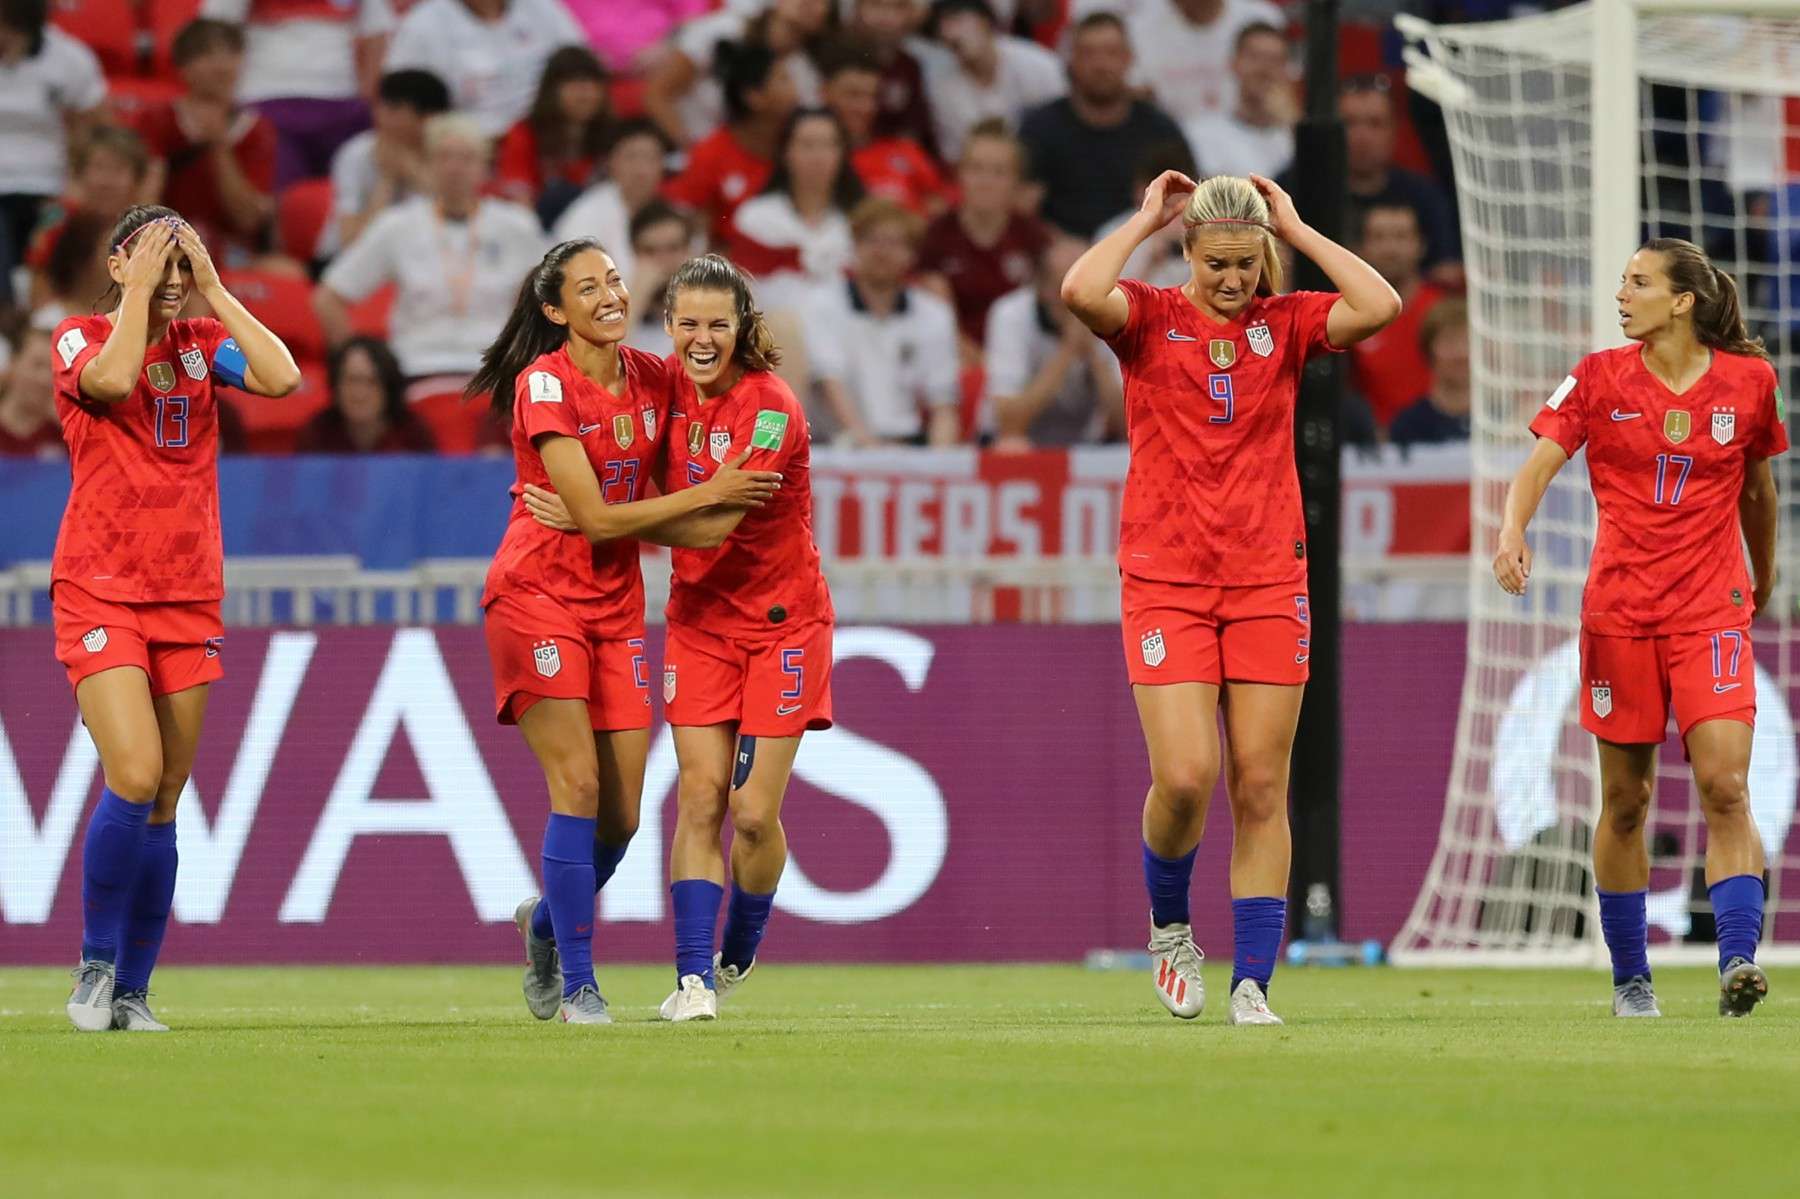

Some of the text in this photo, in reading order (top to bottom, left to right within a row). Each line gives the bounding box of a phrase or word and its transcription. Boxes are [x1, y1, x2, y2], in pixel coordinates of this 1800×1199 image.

[1248, 327, 1268, 340] USA
[182, 351, 203, 365] USA
[1208, 373, 1233, 423] 9
[154, 395, 189, 448] 13
[1714, 415, 1733, 428] USA
[711, 434, 729, 447] USA
[603, 457, 640, 505] 23
[1655, 453, 1694, 506] 17
[1143, 637, 1161, 650] USA
[535, 647, 556, 661] USA
[1711, 630, 1743, 678] 17
[780, 648, 804, 698] 5
[1593, 688, 1610, 701] USA
